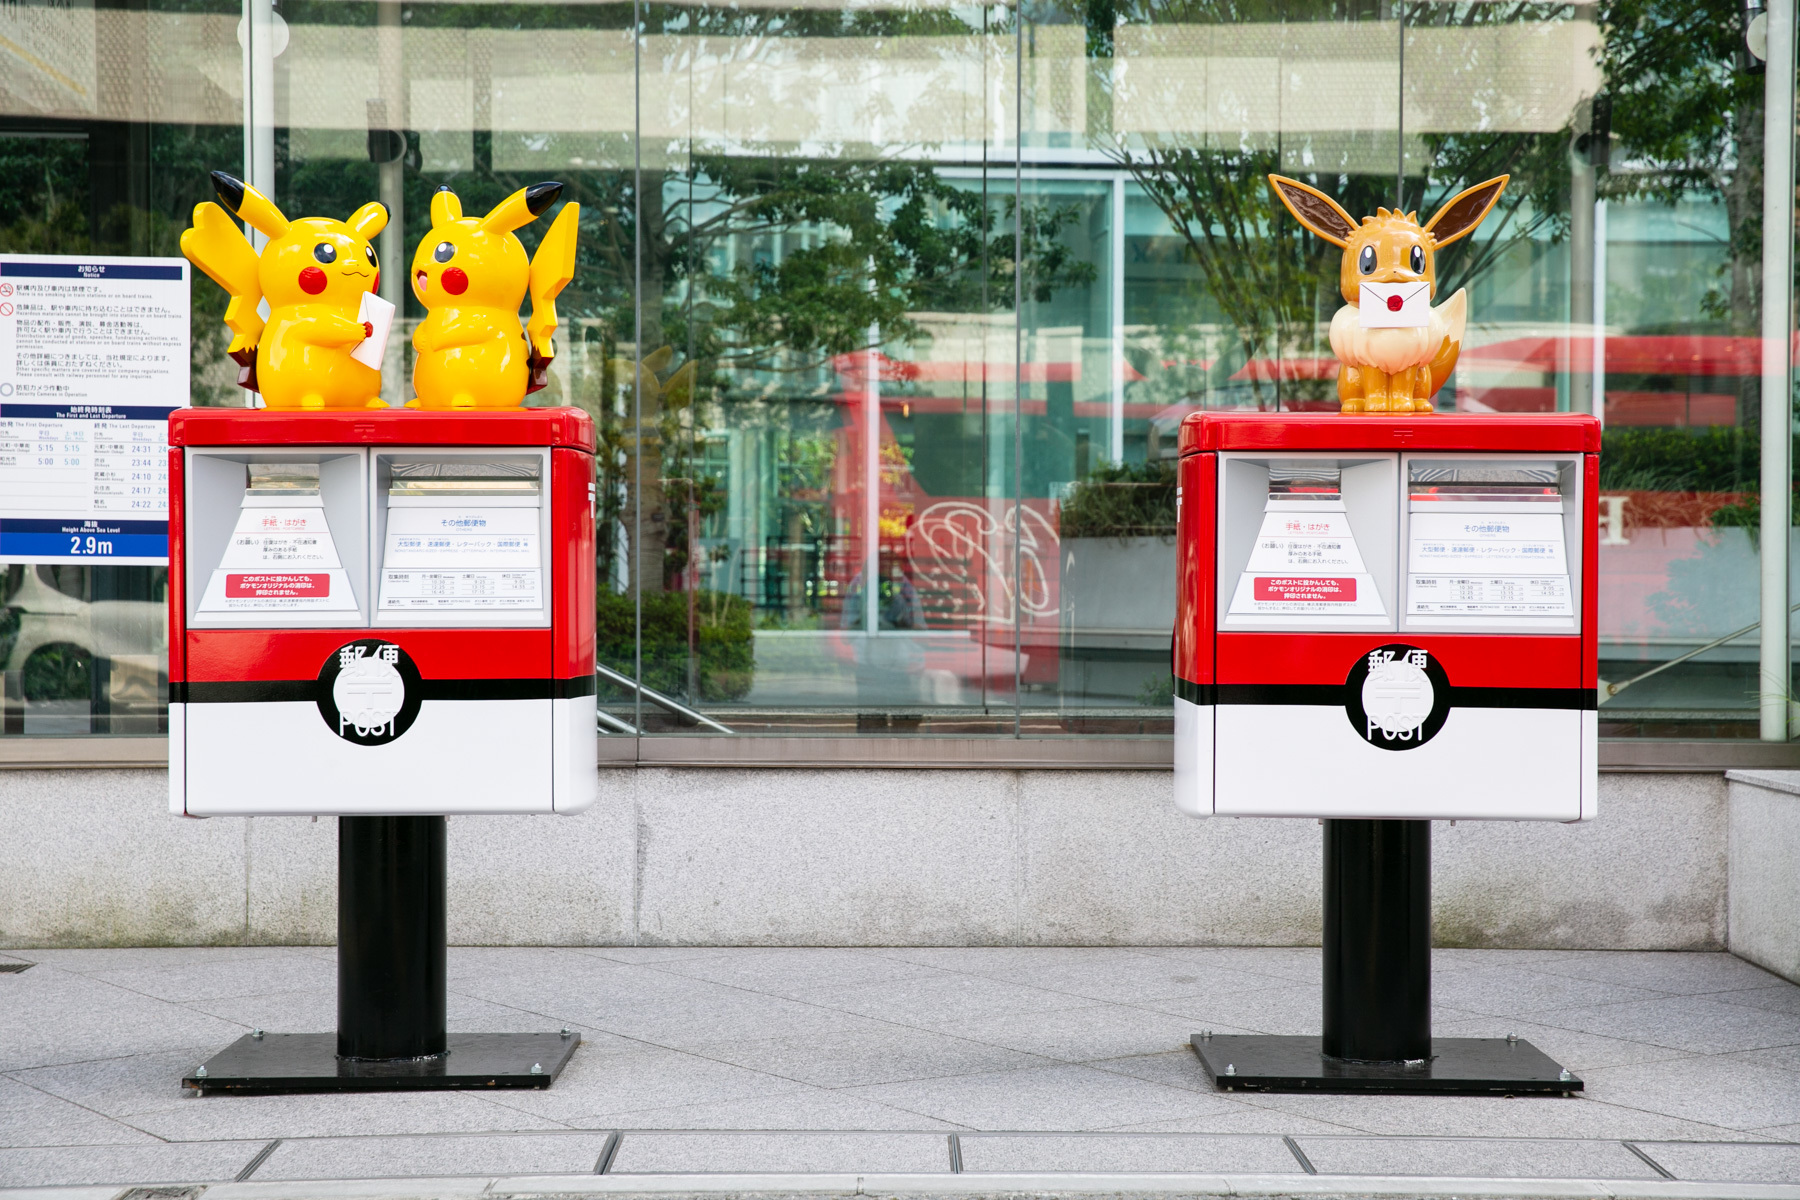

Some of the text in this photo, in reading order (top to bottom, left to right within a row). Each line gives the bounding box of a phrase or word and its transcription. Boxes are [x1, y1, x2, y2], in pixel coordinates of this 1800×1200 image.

[262, 518, 307, 527] 手紙・はがき
[70, 536, 113, 554] 2.9m
[340, 645, 399, 678] 郵便
[1368, 650, 1428, 682] 郵便
[340, 711, 396, 736] POST
[1368, 716, 1426, 740] POST
